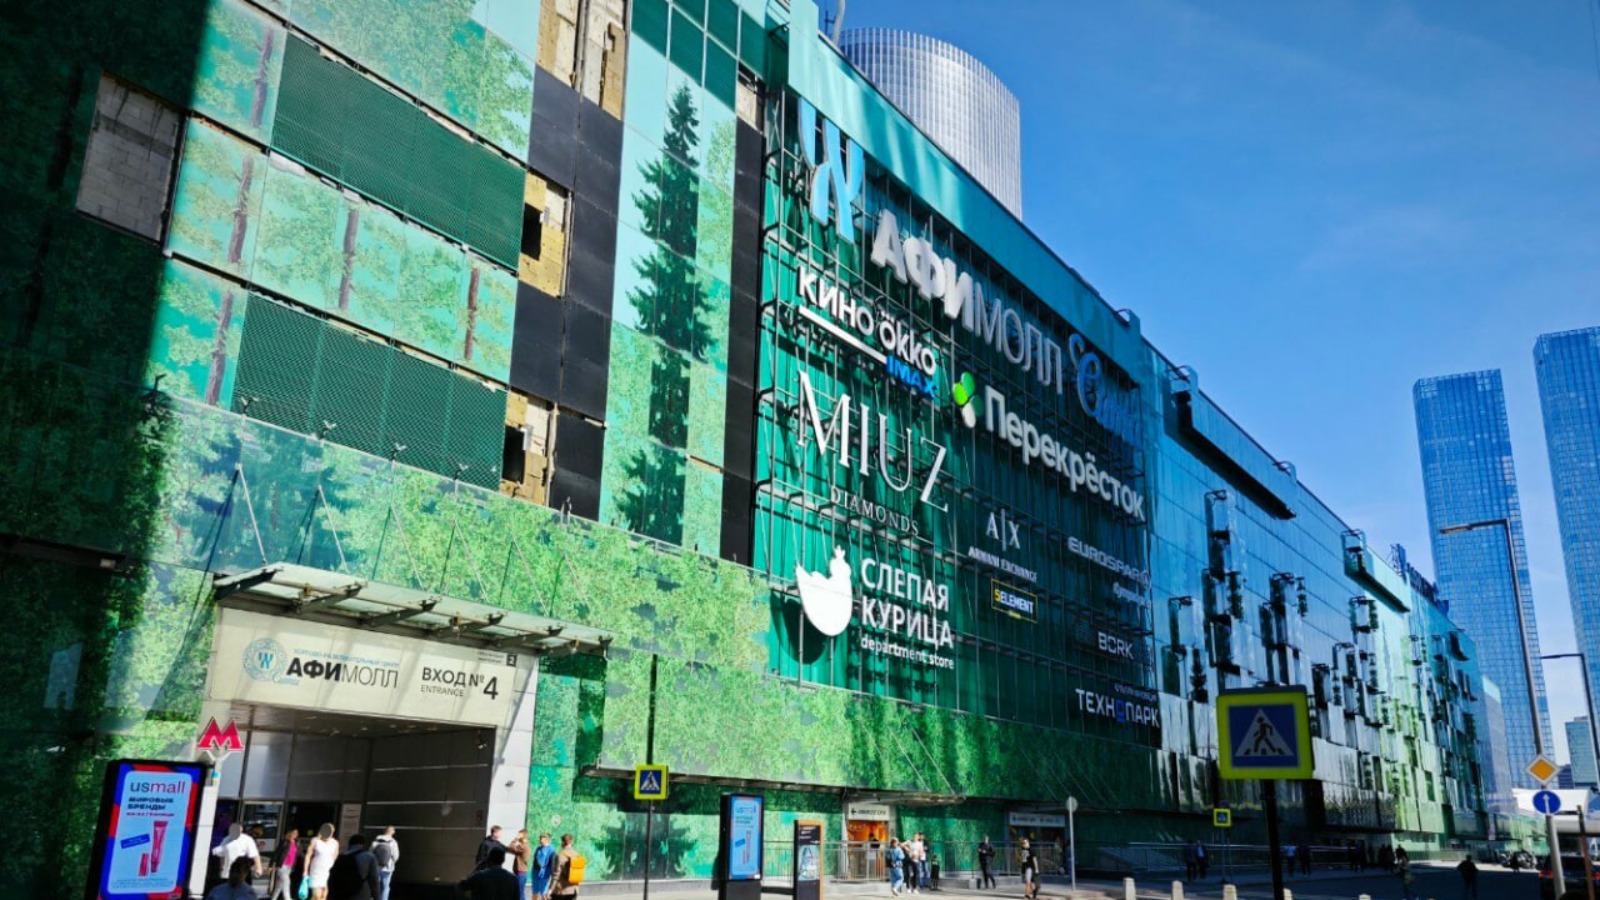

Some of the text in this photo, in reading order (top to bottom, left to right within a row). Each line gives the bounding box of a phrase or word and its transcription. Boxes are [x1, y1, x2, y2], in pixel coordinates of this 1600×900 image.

[799, 265, 874, 336] КИНО
[871, 208, 1063, 395] АФИМОЛЛ
[885, 354, 937, 398] IMAX
[796, 370, 949, 513] MIUZ
[985, 385, 1146, 522] Перекрёсток
[831, 485, 920, 537] DIAMONDS
[861, 558, 949, 612] СЛЕПАЯ
[862, 595, 954, 651] КУРИЦА
[286, 657, 399, 689] АФИМОЛЛ
[861, 634, 955, 670] department store
[420, 685, 464, 697] ENTRANCE
[422, 667, 466, 687] ВХОД
[483, 676, 499, 701] 4
[1075, 688, 1160, 728] ТЕХНОПАРК
[129, 780, 186, 794] usmall
